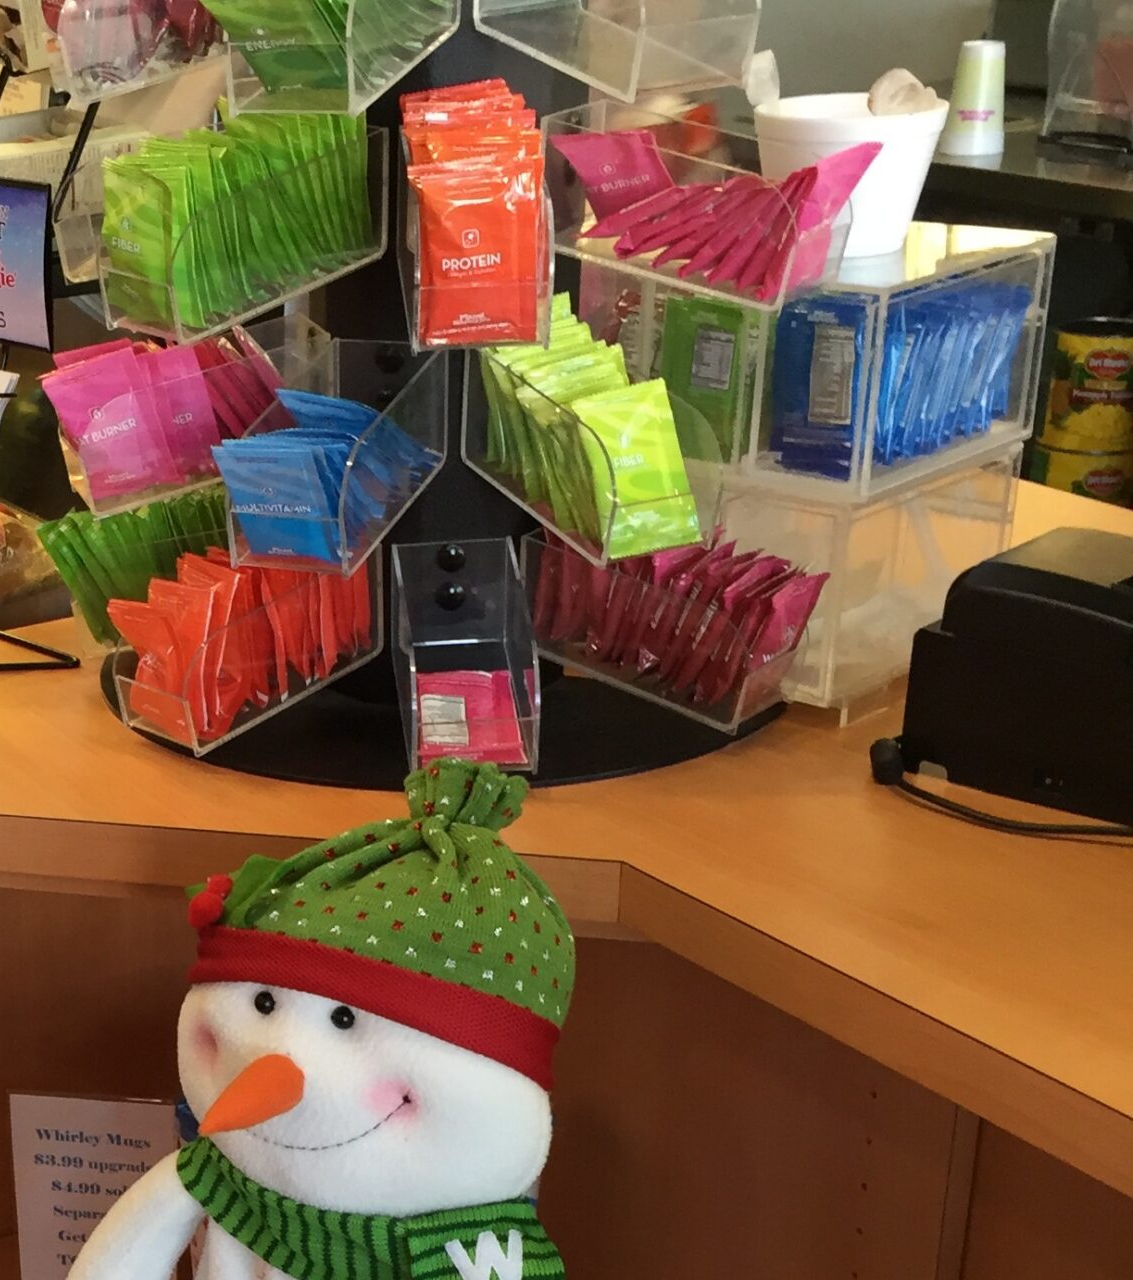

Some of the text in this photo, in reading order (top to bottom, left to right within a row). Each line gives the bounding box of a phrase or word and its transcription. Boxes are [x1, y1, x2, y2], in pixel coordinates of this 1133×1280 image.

[112, 236, 141, 253] FIBER
[441, 252, 502, 272] PROTEIN
[91, 418, 137, 443] BURNER
[35, 1127, 152, 1150] Whirley Mugs
[33, 1153, 84, 1169] $3.99
[51, 1179, 101, 1197] $4.99
